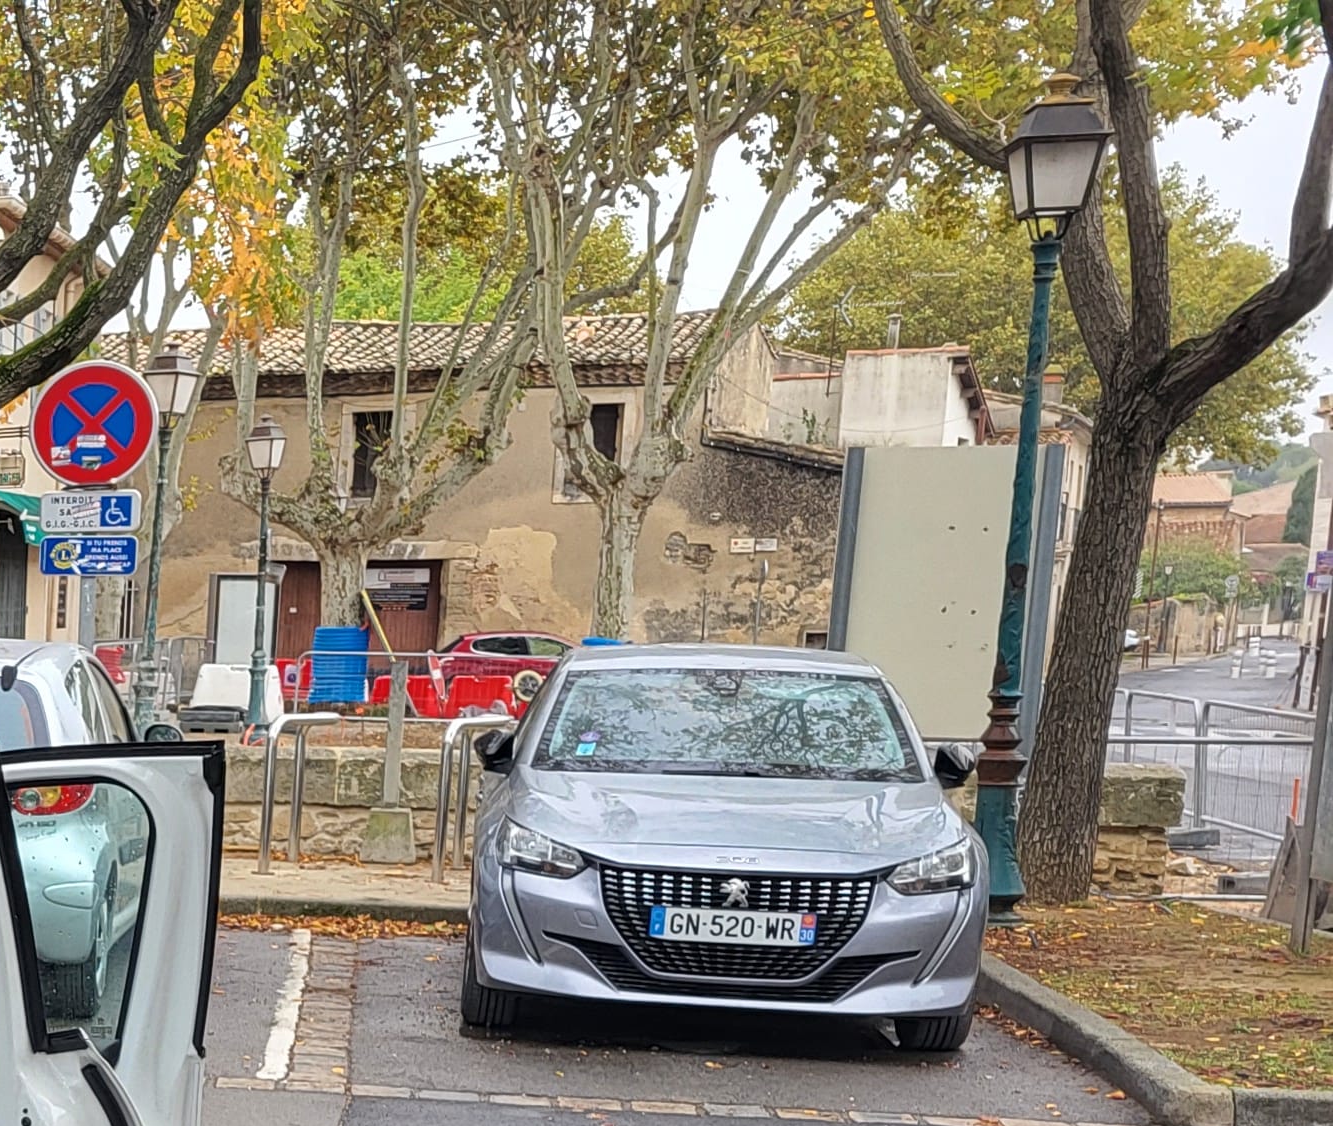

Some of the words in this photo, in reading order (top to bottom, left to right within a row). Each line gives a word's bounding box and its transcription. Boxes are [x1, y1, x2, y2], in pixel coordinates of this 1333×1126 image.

[50, 496, 94, 505] INTERDIT
[59, 508, 71, 516] SA
[669, 912, 796, 941] GN-520-WR
[800, 929, 815, 941] 30
